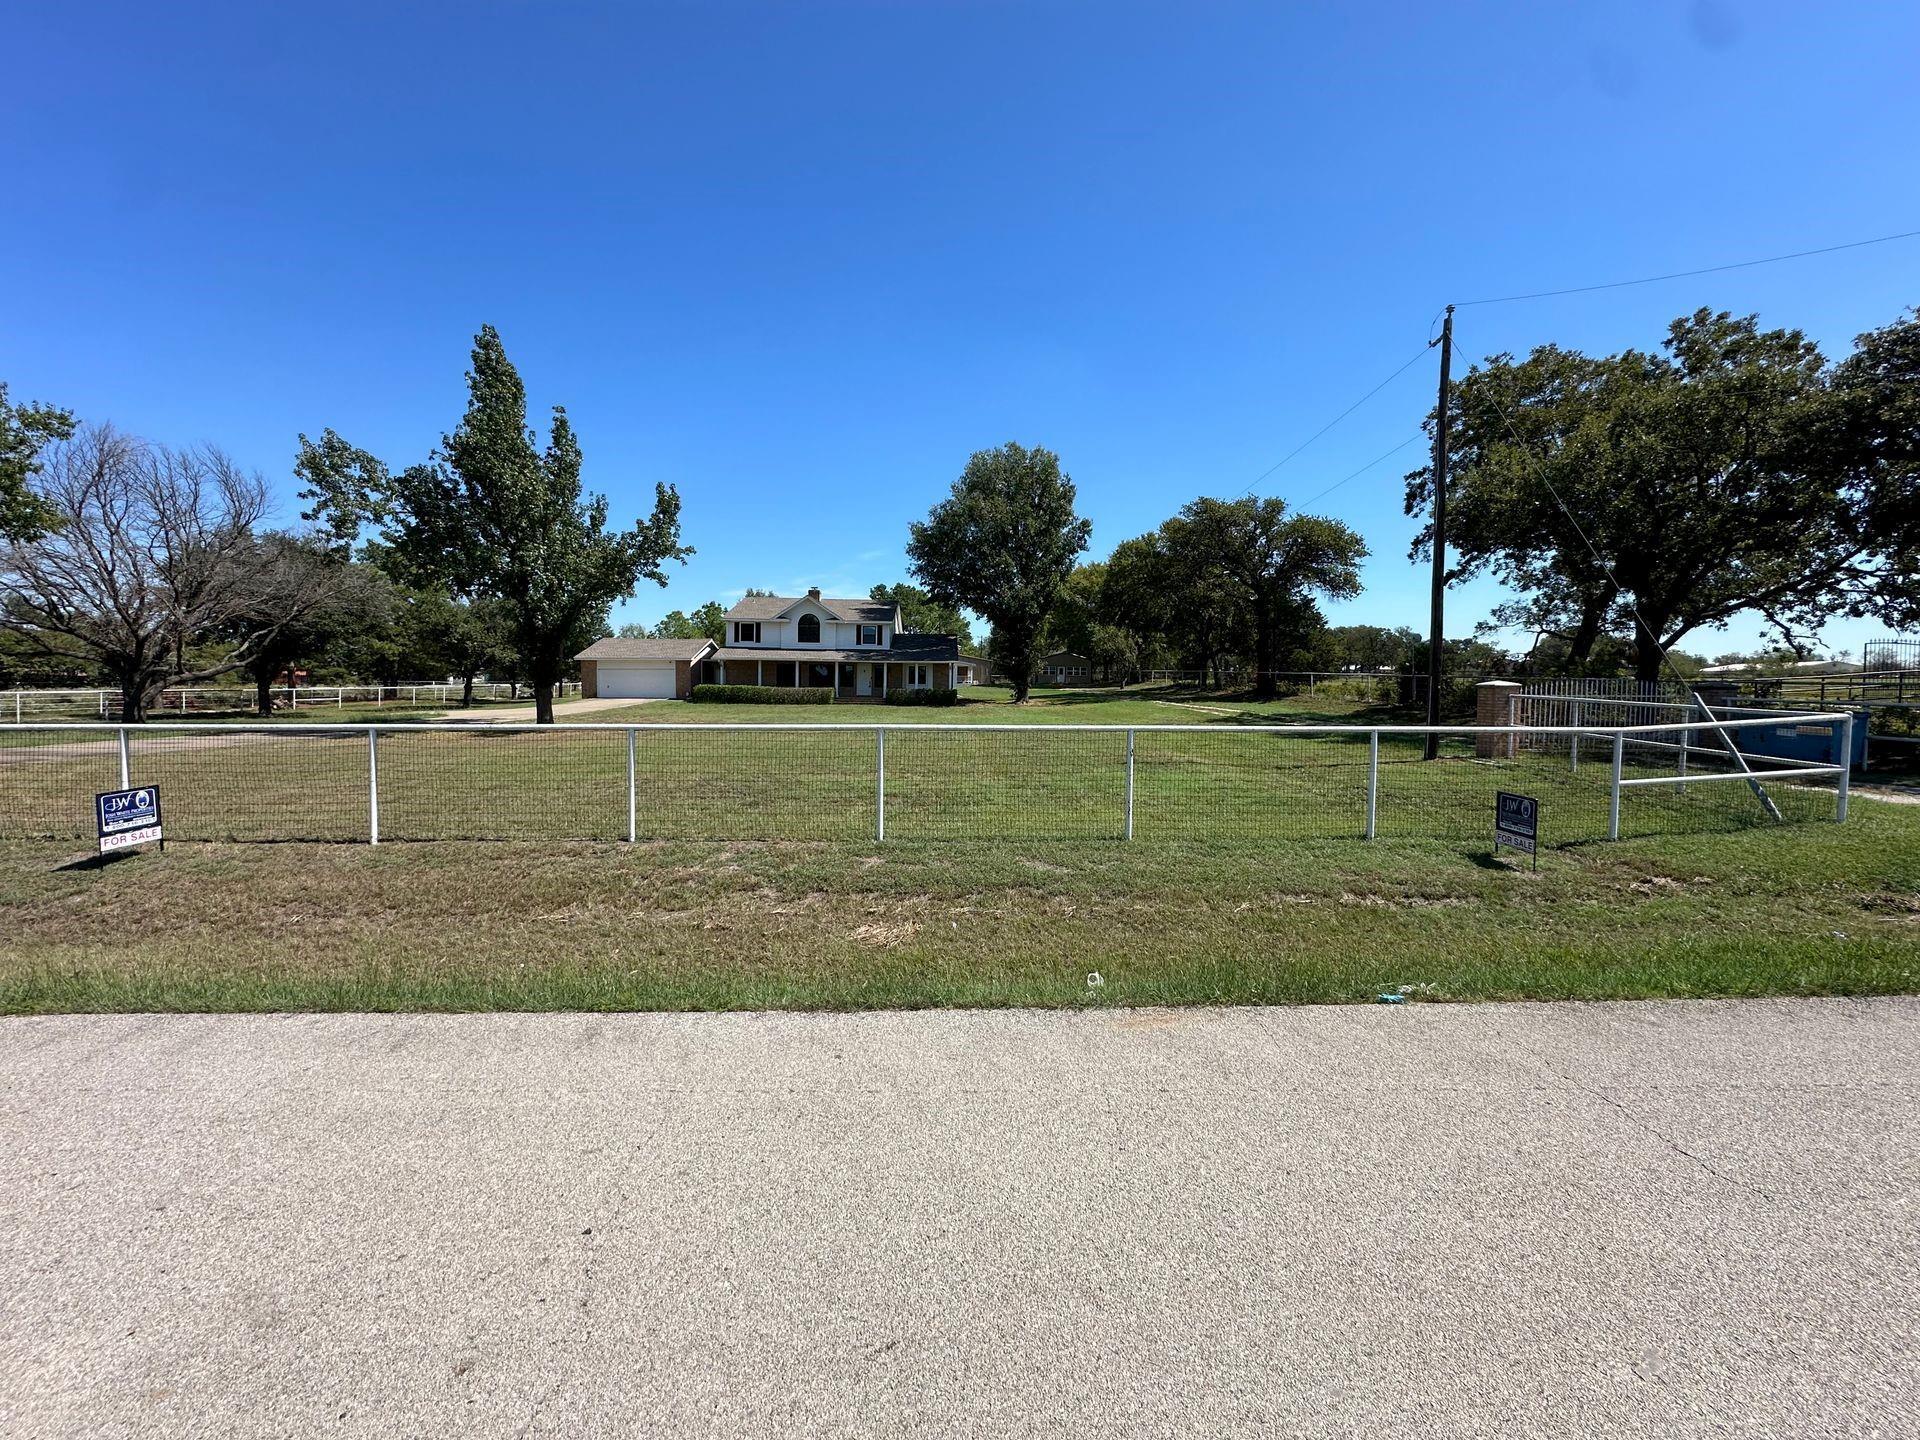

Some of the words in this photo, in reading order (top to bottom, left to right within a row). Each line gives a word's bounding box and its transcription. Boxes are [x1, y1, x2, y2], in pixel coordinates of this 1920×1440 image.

[103, 835, 127, 847] FOR
[131, 829, 158, 841] SALE
[1497, 833, 1512, 843] FOR
[1513, 837, 1534, 851] SALE
